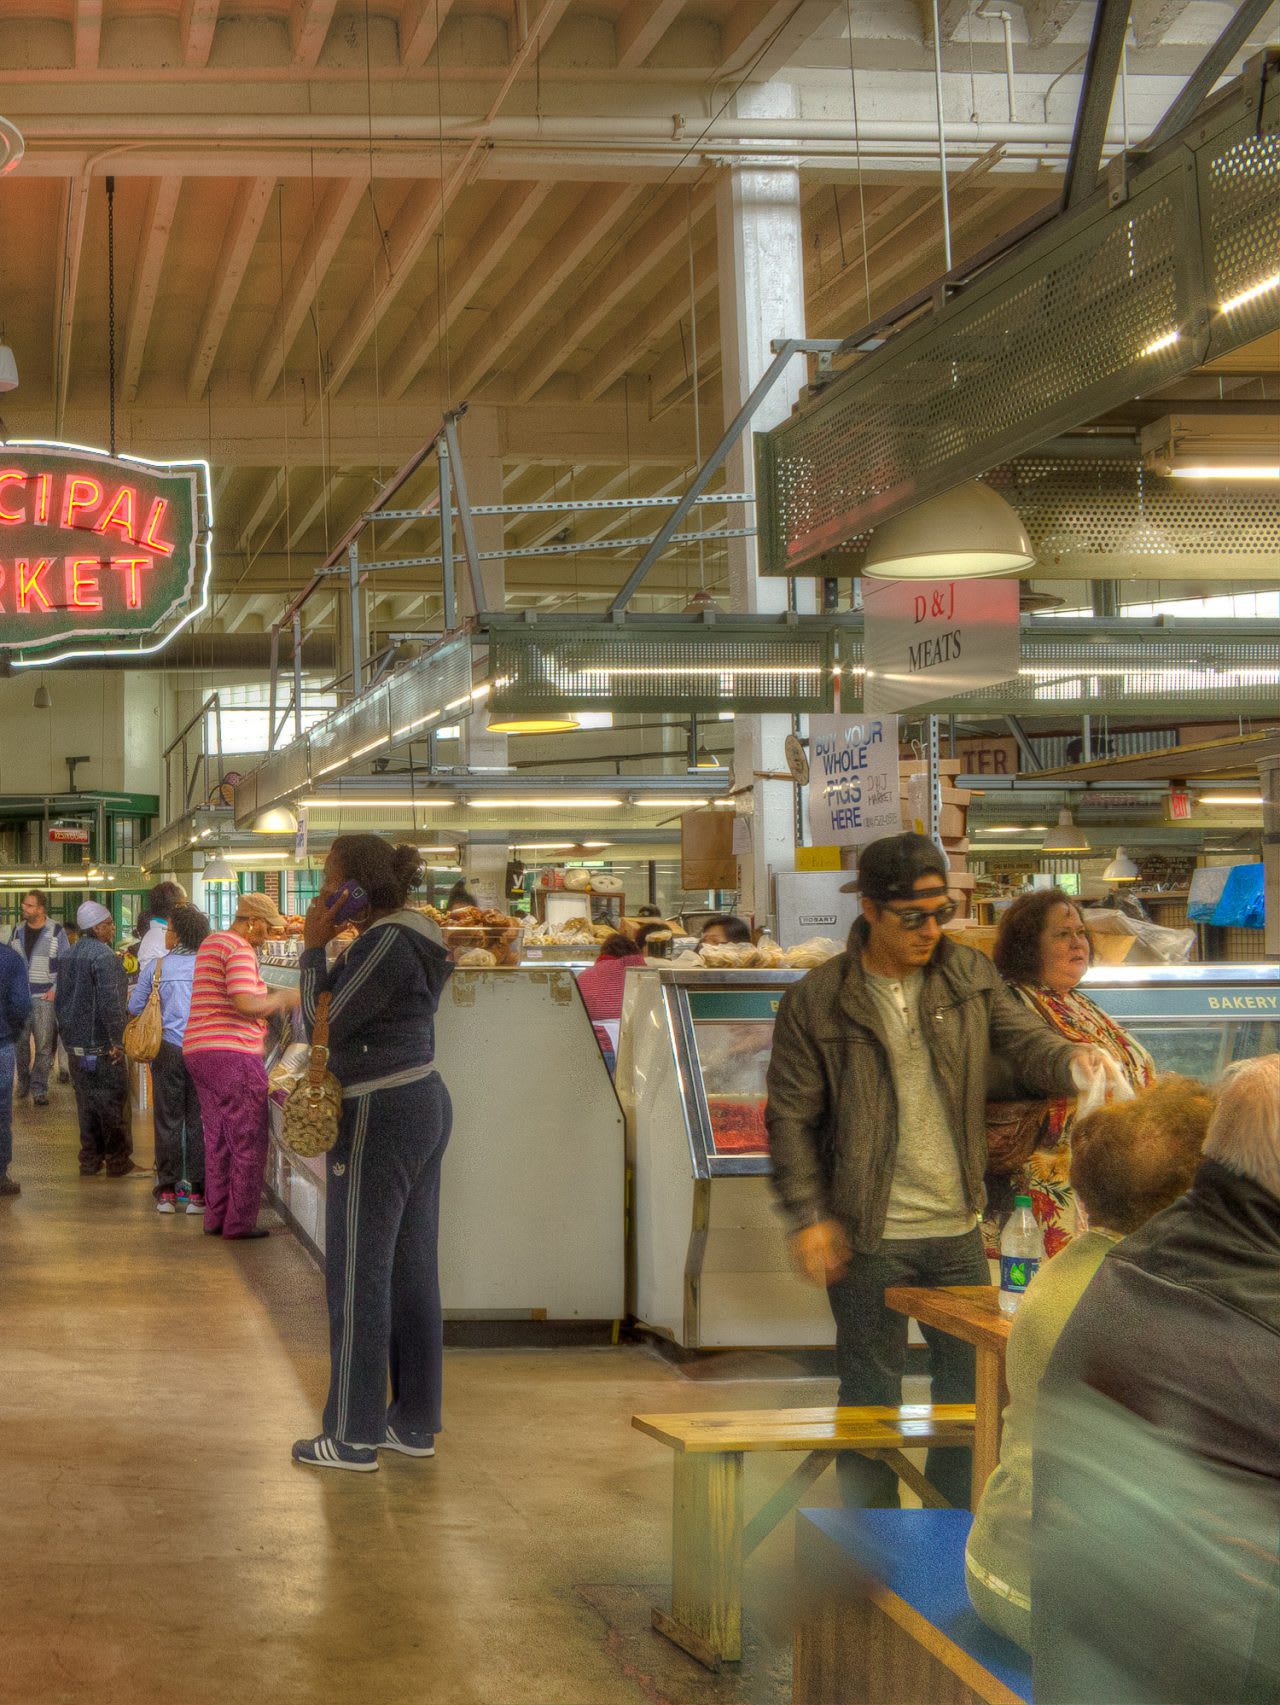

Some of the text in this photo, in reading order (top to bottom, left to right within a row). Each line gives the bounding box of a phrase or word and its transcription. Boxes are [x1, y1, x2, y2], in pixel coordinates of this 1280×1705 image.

[913, 595, 927, 625] D
[947, 582, 956, 621] J
[908, 629, 962, 673] MEATS
[815, 721, 883, 756] BUY YOUR
[822, 746, 868, 776] WHOLE
[825, 774, 862, 807] PIGS
[830, 806, 863, 831] HERE
[1207, 996, 1278, 1009] BAKERY
